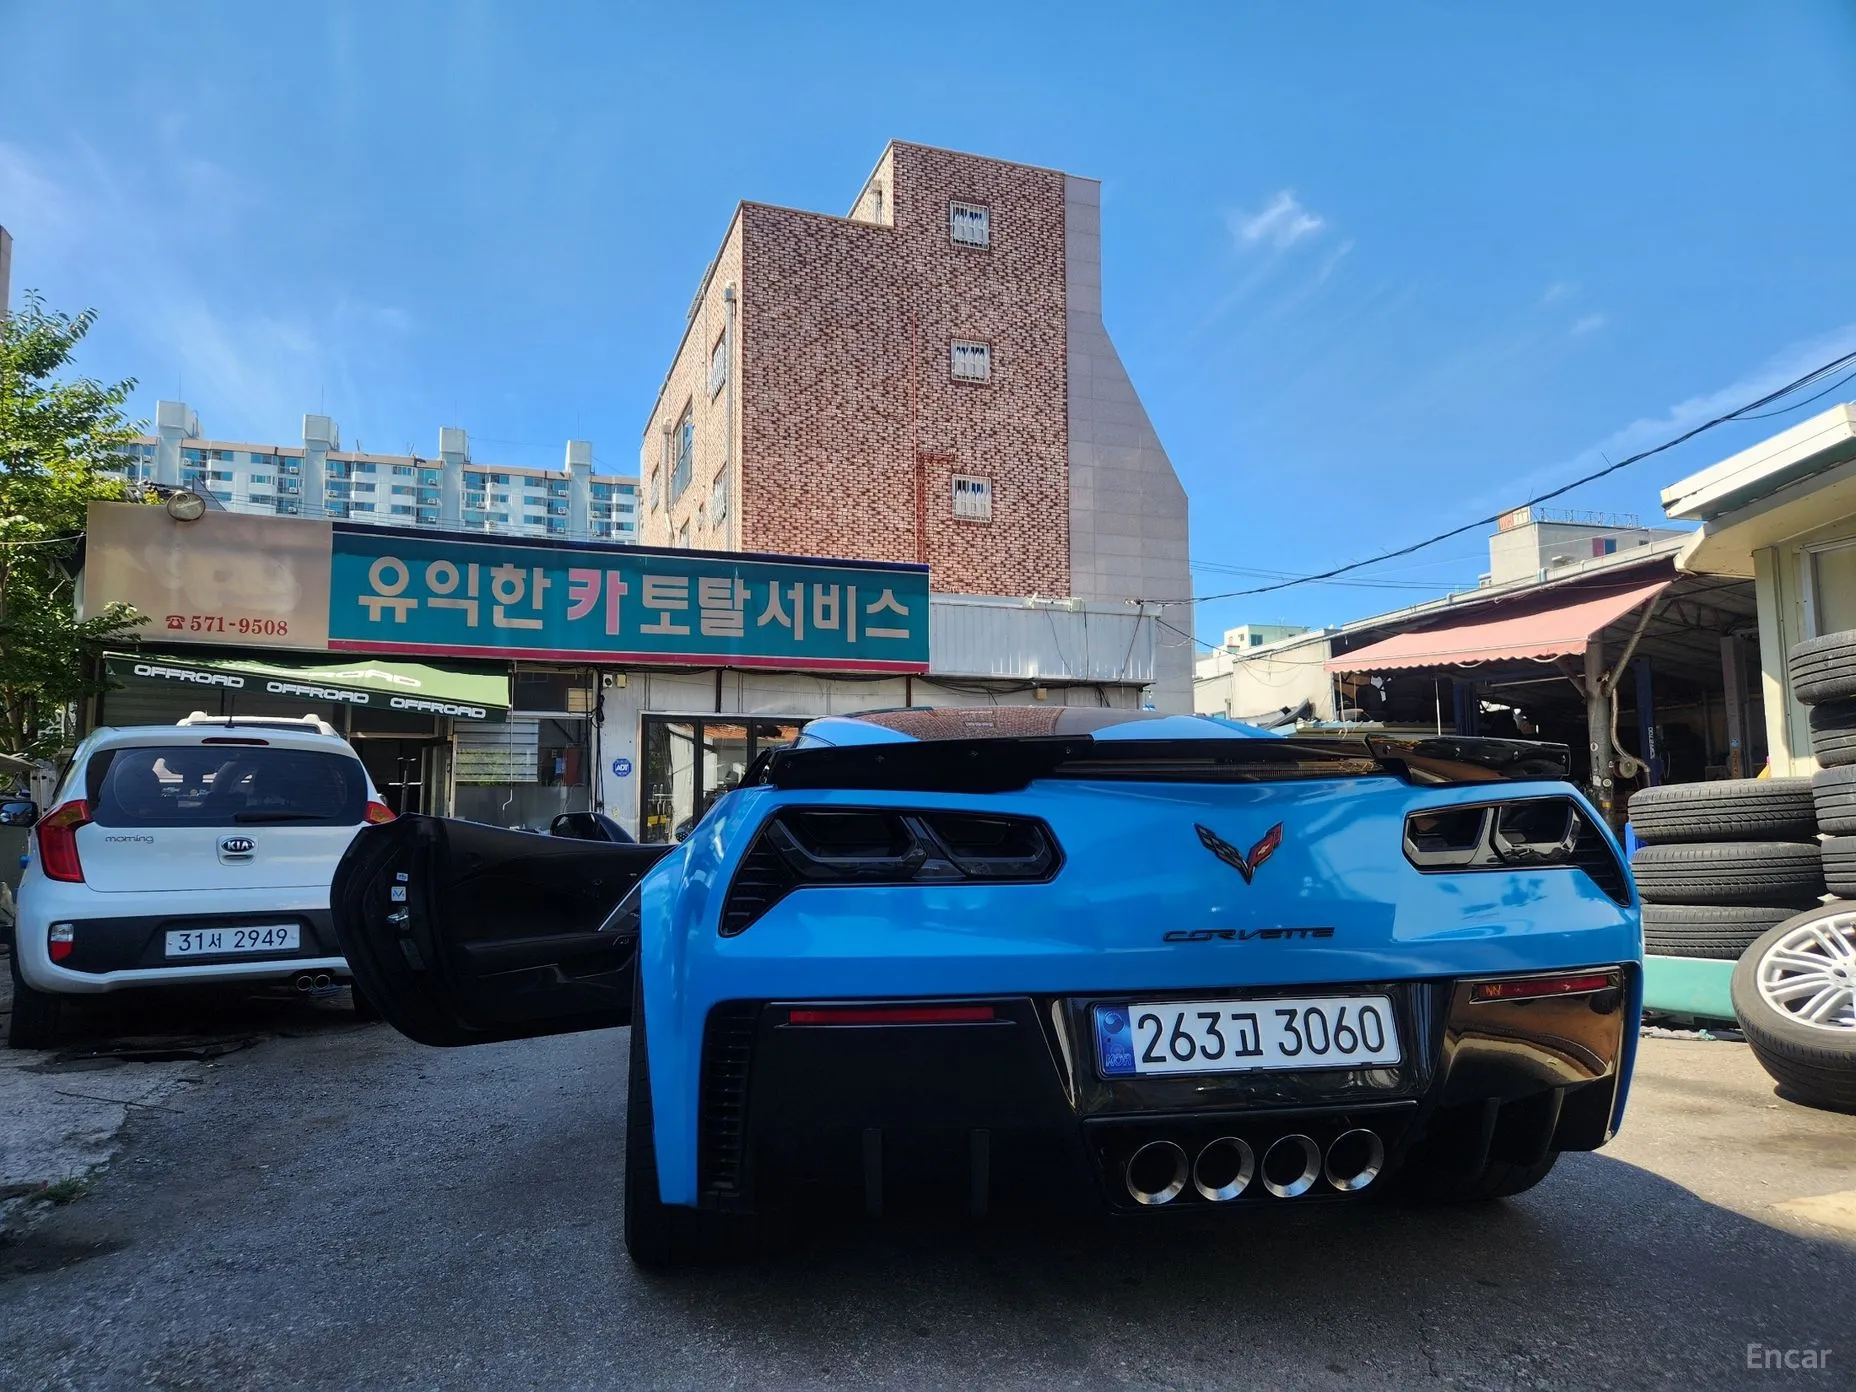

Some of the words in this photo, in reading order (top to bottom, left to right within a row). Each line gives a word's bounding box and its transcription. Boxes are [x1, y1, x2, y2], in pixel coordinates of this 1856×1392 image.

[358, 555, 552, 630] 유익한
[566, 568, 628, 636] 카
[639, 575, 911, 643] 토탈서비스
[190, 615, 288, 636] 571-9508
[133, 664, 245, 688] OFFROAD
[266, 681, 370, 704] OFFROAD
[389, 697, 487, 719] OFFROAD
[226, 841, 250, 850] KIA
[178, 932, 221, 952] 31서
[233, 928, 288, 948] 2949
[1162, 926, 1336, 943] CORVETTE
[1137, 1012, 1264, 1064] 263고
[1274, 1005, 1385, 1057] 3060
